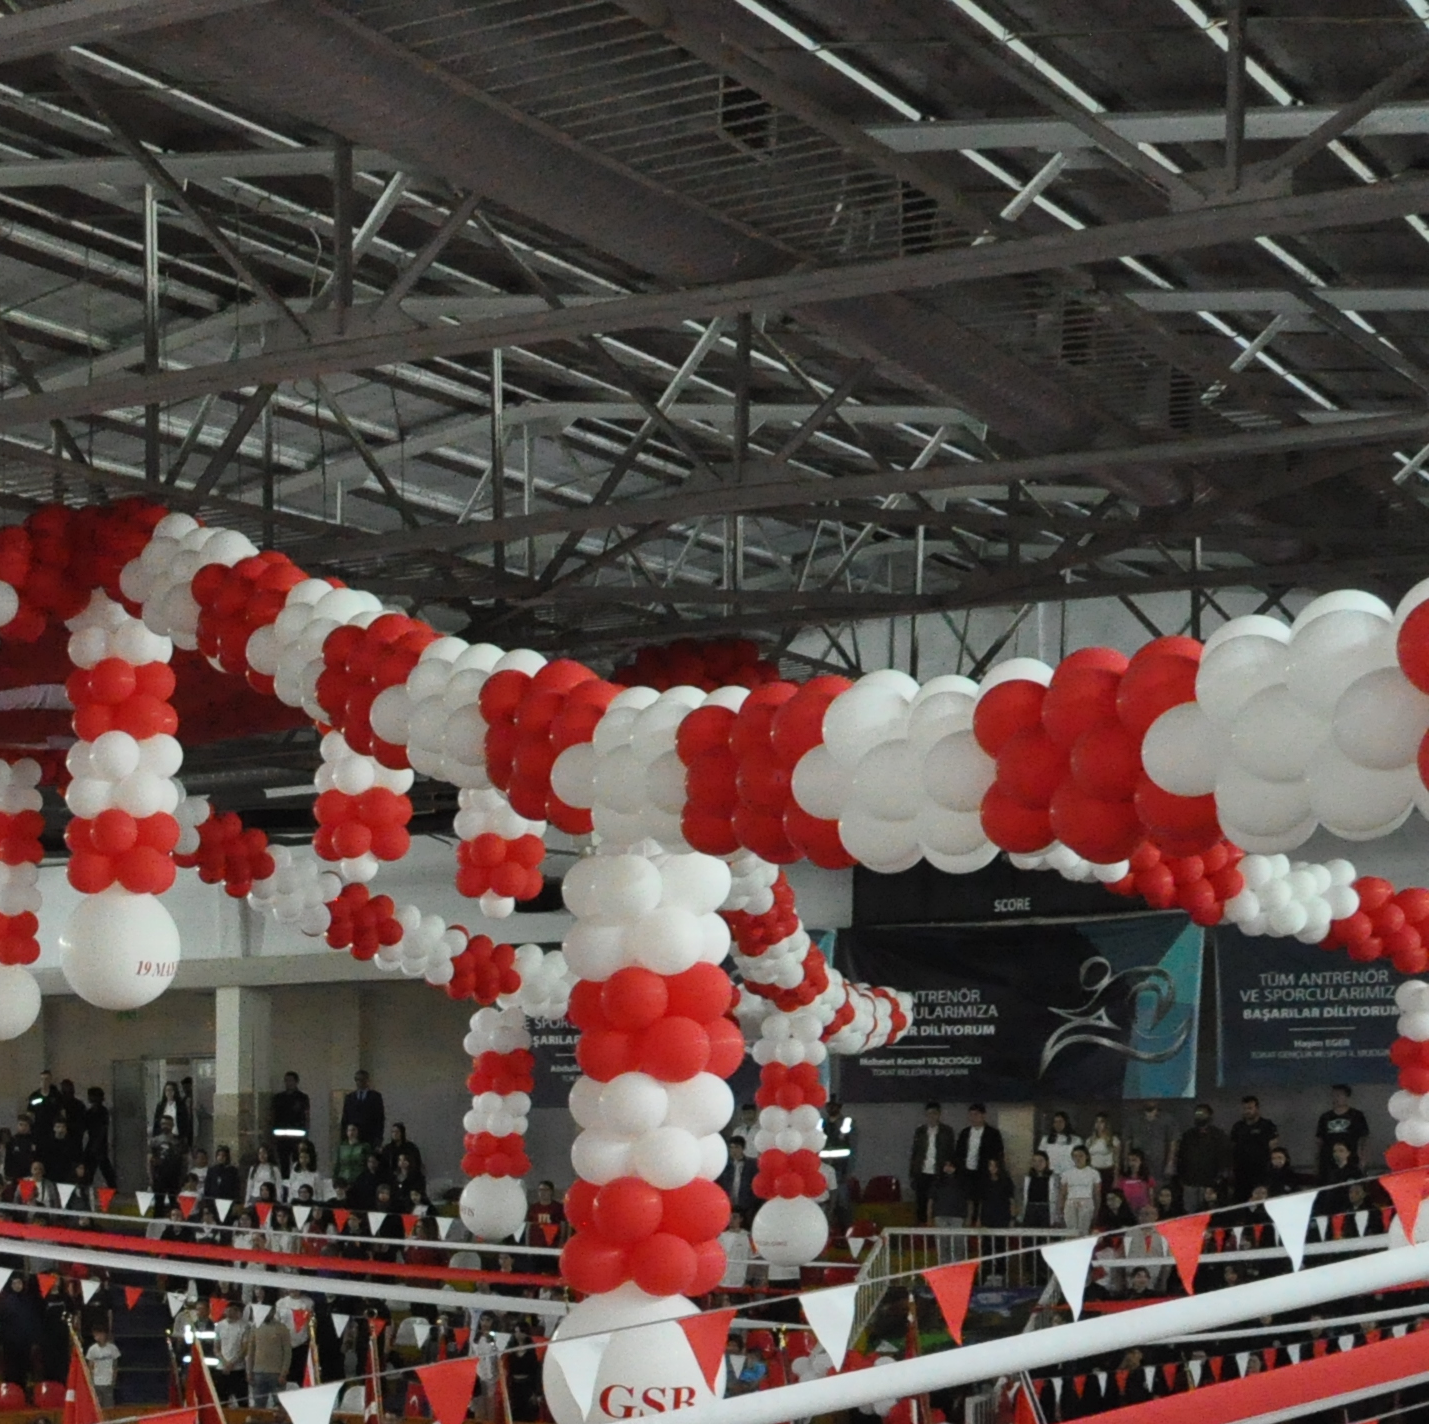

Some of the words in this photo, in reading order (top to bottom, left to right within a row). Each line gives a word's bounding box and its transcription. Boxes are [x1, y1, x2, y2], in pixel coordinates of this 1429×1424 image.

[994, 898, 1031, 912] SCORE
[135, 960, 152, 975] 19
[1259, 971, 1294, 986] TÜM
[1299, 969, 1389, 985] ANTRENÖR
[911, 987, 981, 1004] NTRENÖR
[1240, 989, 1260, 1003] VE
[1243, 1007, 1320, 1022] BAŞARILAR
[920, 1023, 995, 1037] DİLİYORUM
